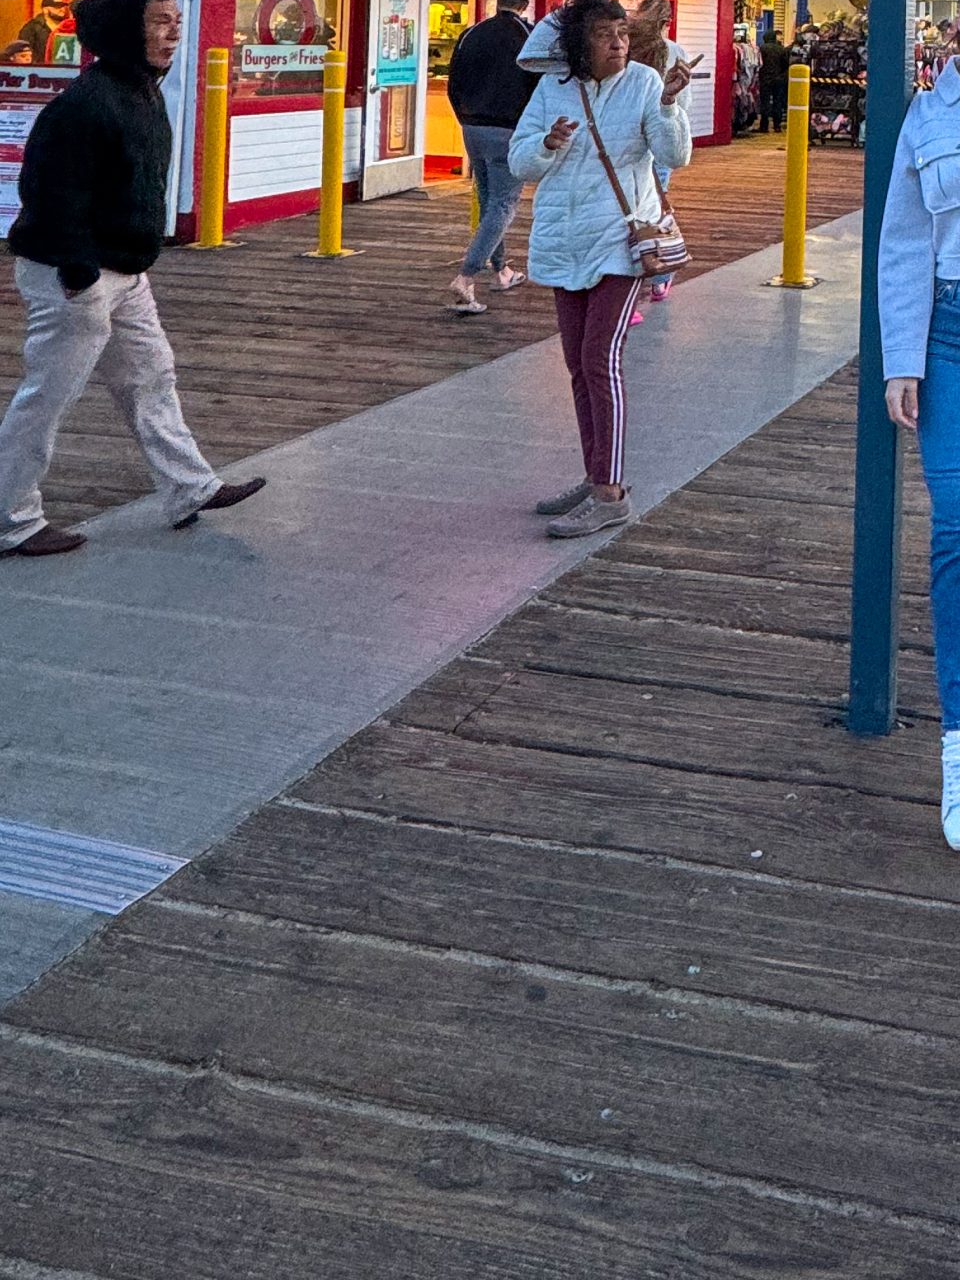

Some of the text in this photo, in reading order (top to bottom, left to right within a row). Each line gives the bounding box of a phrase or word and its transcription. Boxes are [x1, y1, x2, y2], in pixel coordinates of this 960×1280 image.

[55, 41, 70, 60] A
[244, 49, 288, 70] Burgers
[298, 48, 325, 65] Fries
